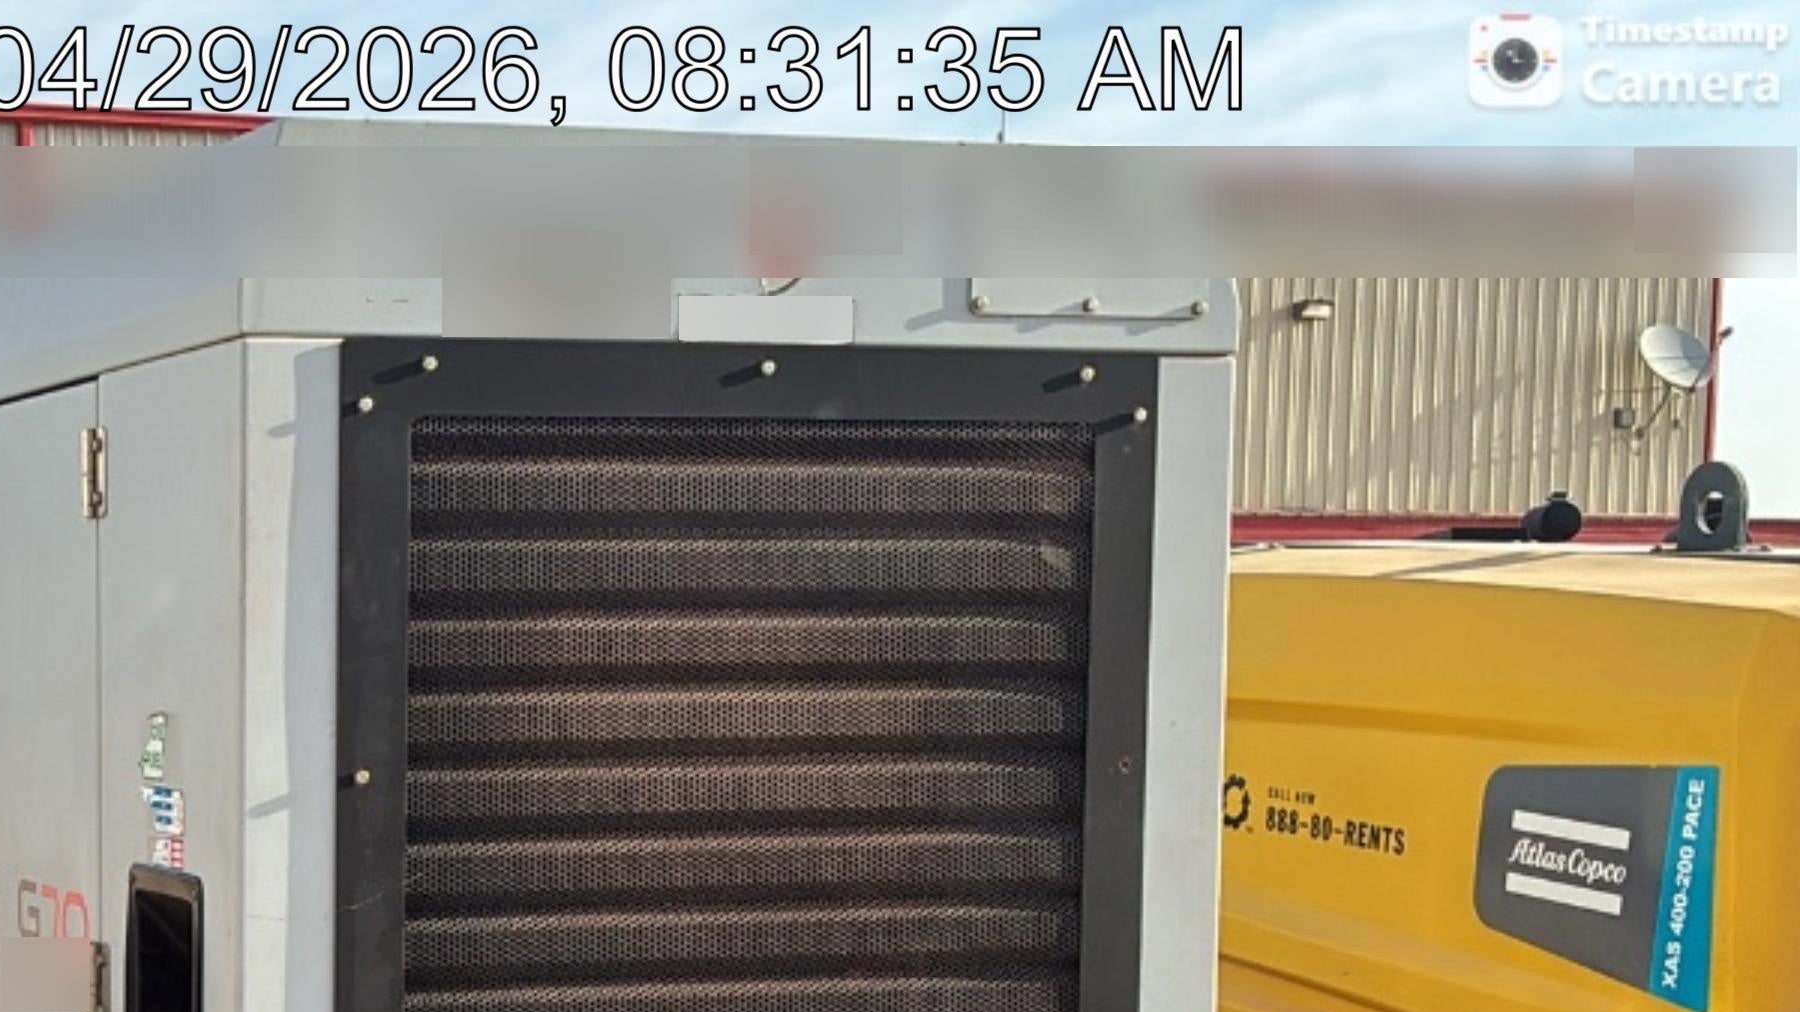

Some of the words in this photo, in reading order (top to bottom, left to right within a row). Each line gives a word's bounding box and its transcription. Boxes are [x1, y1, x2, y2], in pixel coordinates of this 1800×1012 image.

[1265, 806, 1405, 856] 888-80-RENTS
[1509, 838, 1566, 873] Atlas
[1568, 848, 1627, 884] Copco
[1662, 941, 1682, 988] XAS
[1682, 779, 1706, 841] PACE
